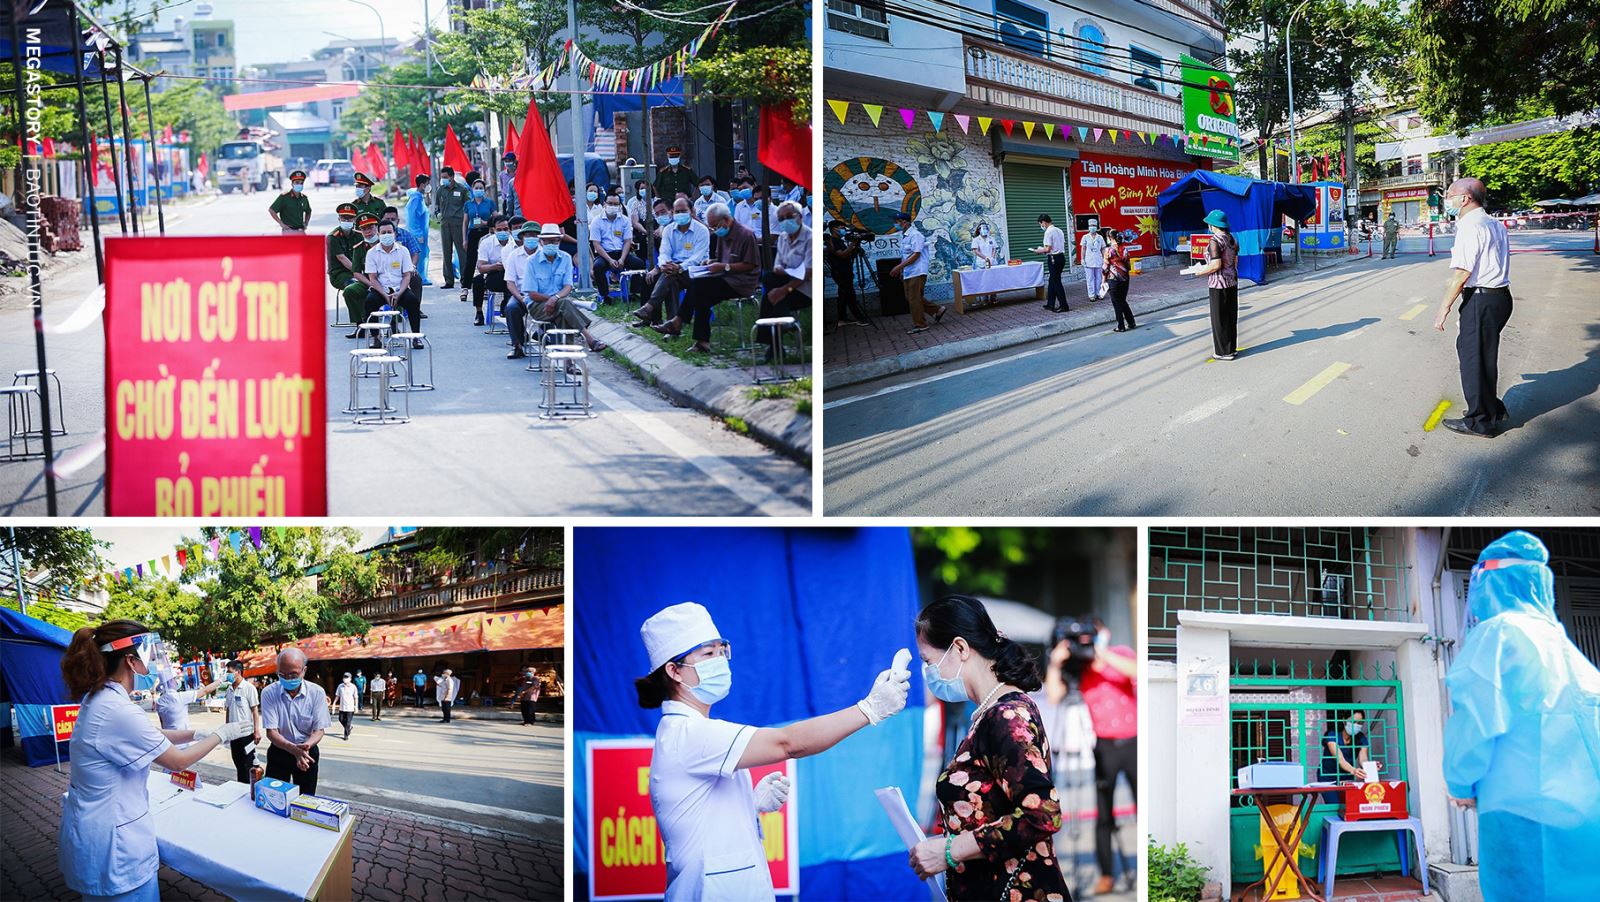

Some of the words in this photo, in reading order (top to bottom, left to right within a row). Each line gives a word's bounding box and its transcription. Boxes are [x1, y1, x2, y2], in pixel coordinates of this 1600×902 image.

[1081, 160, 1102, 173] Tân
[1104, 163, 1135, 178] Hoàng
[1137, 165, 1158, 178] Minh
[140, 278, 191, 343] NƠI
[198, 256, 241, 343] CỬ
[243, 281, 289, 342] TRI
[116, 363, 176, 440] CHỜ
[180, 357, 239, 440] ĐẾN
[245, 371, 315, 452] LƯỢT
[155, 451, 194, 517] BỎ
[601, 806, 656, 867] CÁCH
